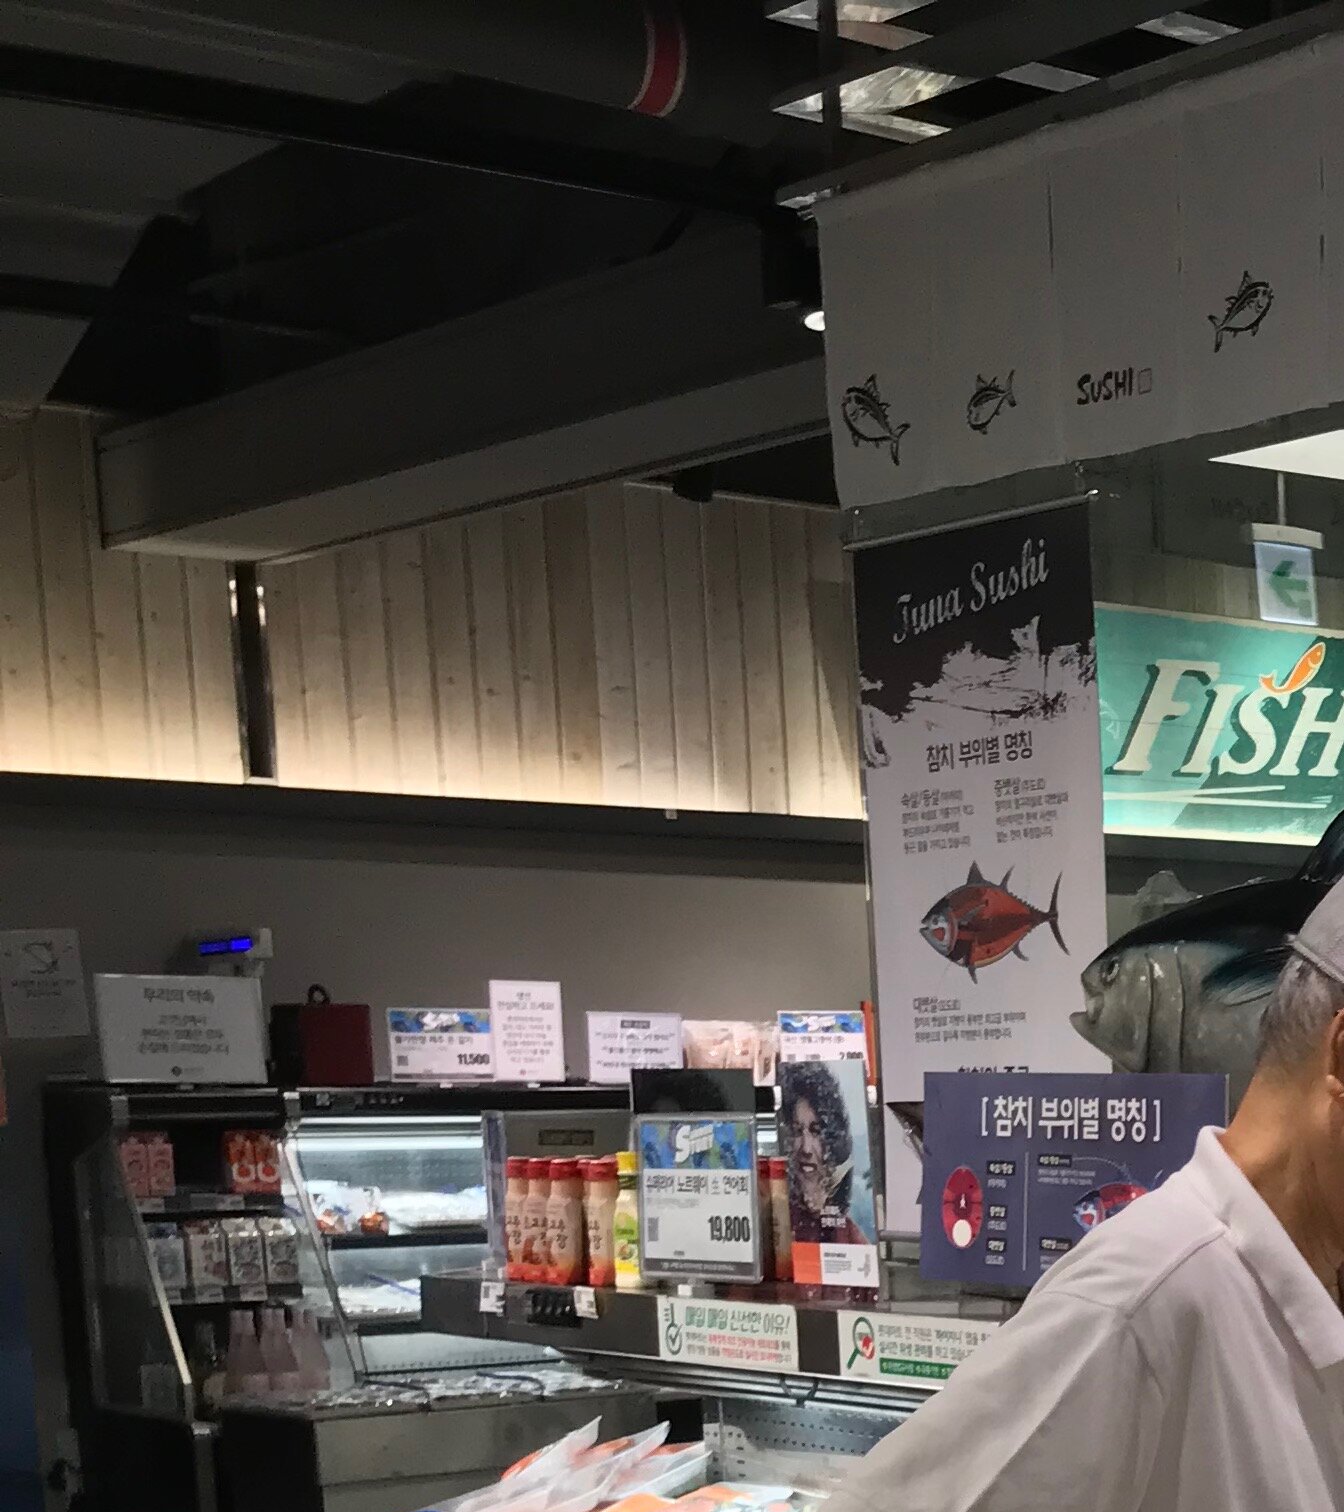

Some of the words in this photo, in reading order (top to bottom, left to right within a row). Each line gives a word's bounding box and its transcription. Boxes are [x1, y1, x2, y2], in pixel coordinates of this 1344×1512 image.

[1077, 368, 1134, 405] SUSHI
[893, 585, 962, 644] Tuna
[969, 538, 1051, 617] Sushi
[926, 742, 955, 773] 참치
[959, 735, 1001, 768] 부위별
[1004, 730, 1033, 760] 명칭
[1038, 1097, 1100, 1140] 부위별
[1107, 1098, 1147, 1142] 명칭
[708, 1215, 751, 1243] 19,800
